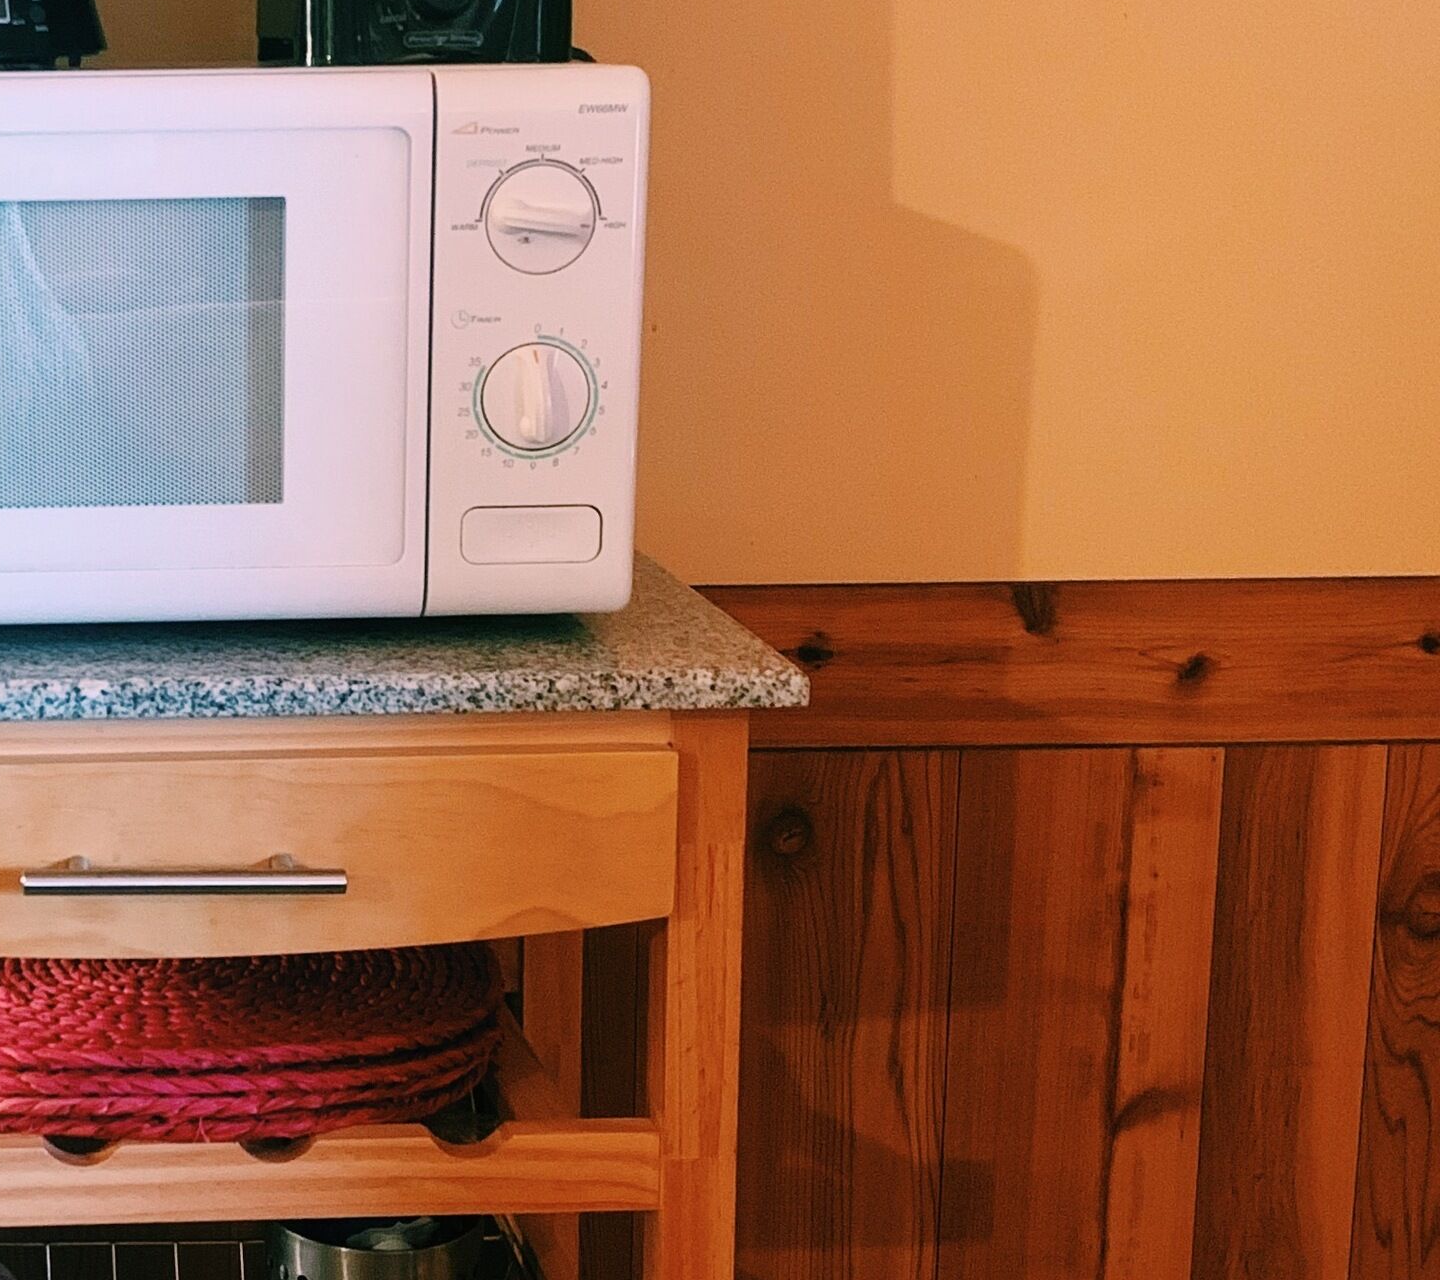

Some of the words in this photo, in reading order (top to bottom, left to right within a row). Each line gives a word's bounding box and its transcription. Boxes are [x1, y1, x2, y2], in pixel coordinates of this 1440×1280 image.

[525, 144, 561, 153] MEDIUM
[534, 324, 542, 334] 0
[581, 339, 588, 349] 2
[469, 357, 481, 367] 35
[594, 357, 601, 367] 3
[601, 380, 608, 390] 4
[599, 406, 605, 415] 5
[465, 429, 478, 439] 20
[481, 448, 492, 457] 15
[573, 447, 580, 456] 7
[503, 459, 514, 468] 10
[530, 461, 536, 470] 9
